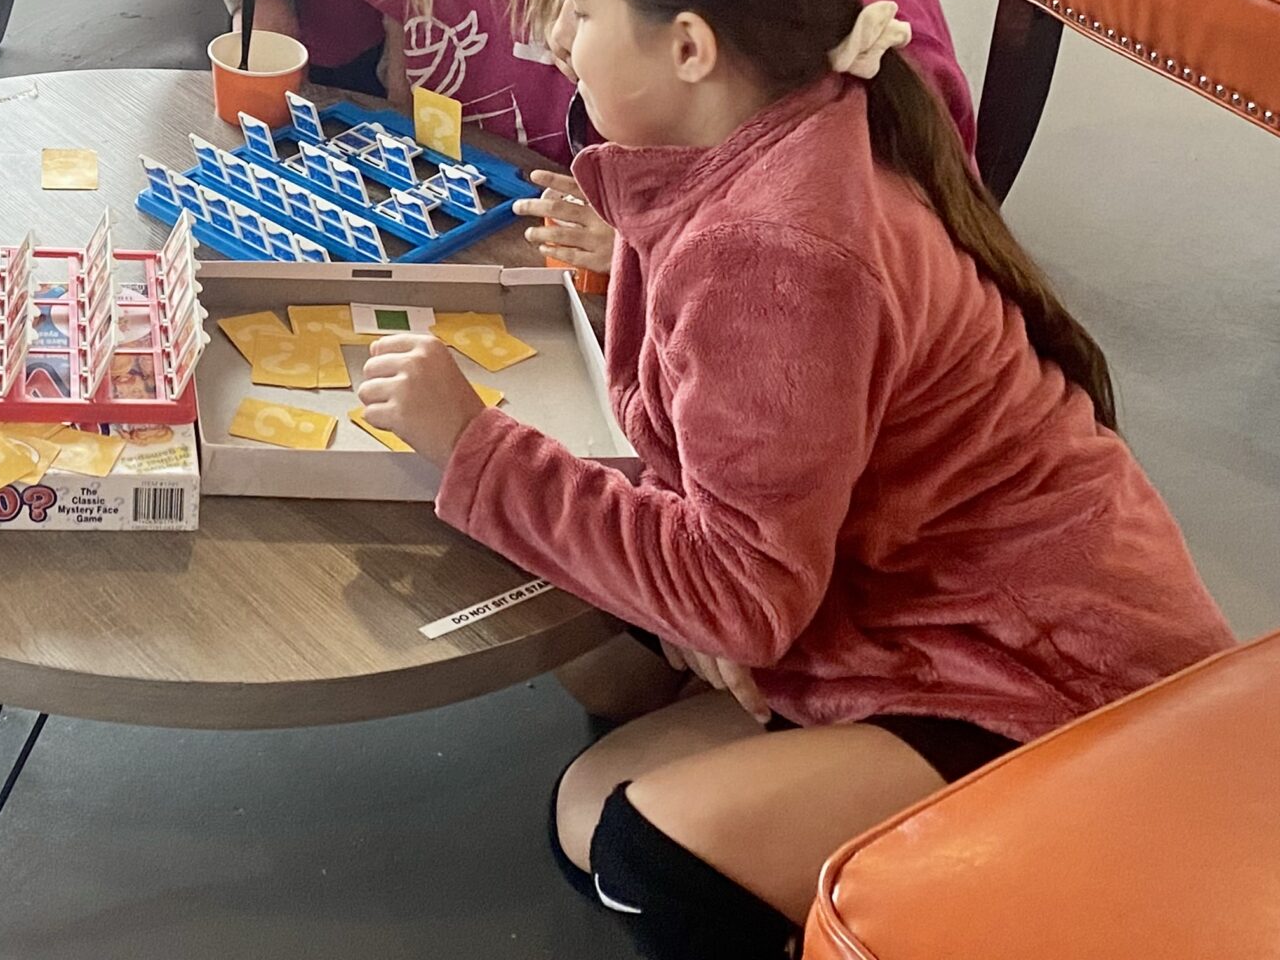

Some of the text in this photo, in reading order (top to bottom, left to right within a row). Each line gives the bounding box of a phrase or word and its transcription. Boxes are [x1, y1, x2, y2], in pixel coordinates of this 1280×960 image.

[81, 487, 98, 496] The
[71, 496, 106, 505] Classic
[57, 505, 120, 516] Mystery Face
[76, 514, 103, 524] Game
[451, 614, 470, 625] DO
[468, 604, 493, 617] NOT
[491, 597, 509, 609] SIT
[508, 590, 527, 602] OR
